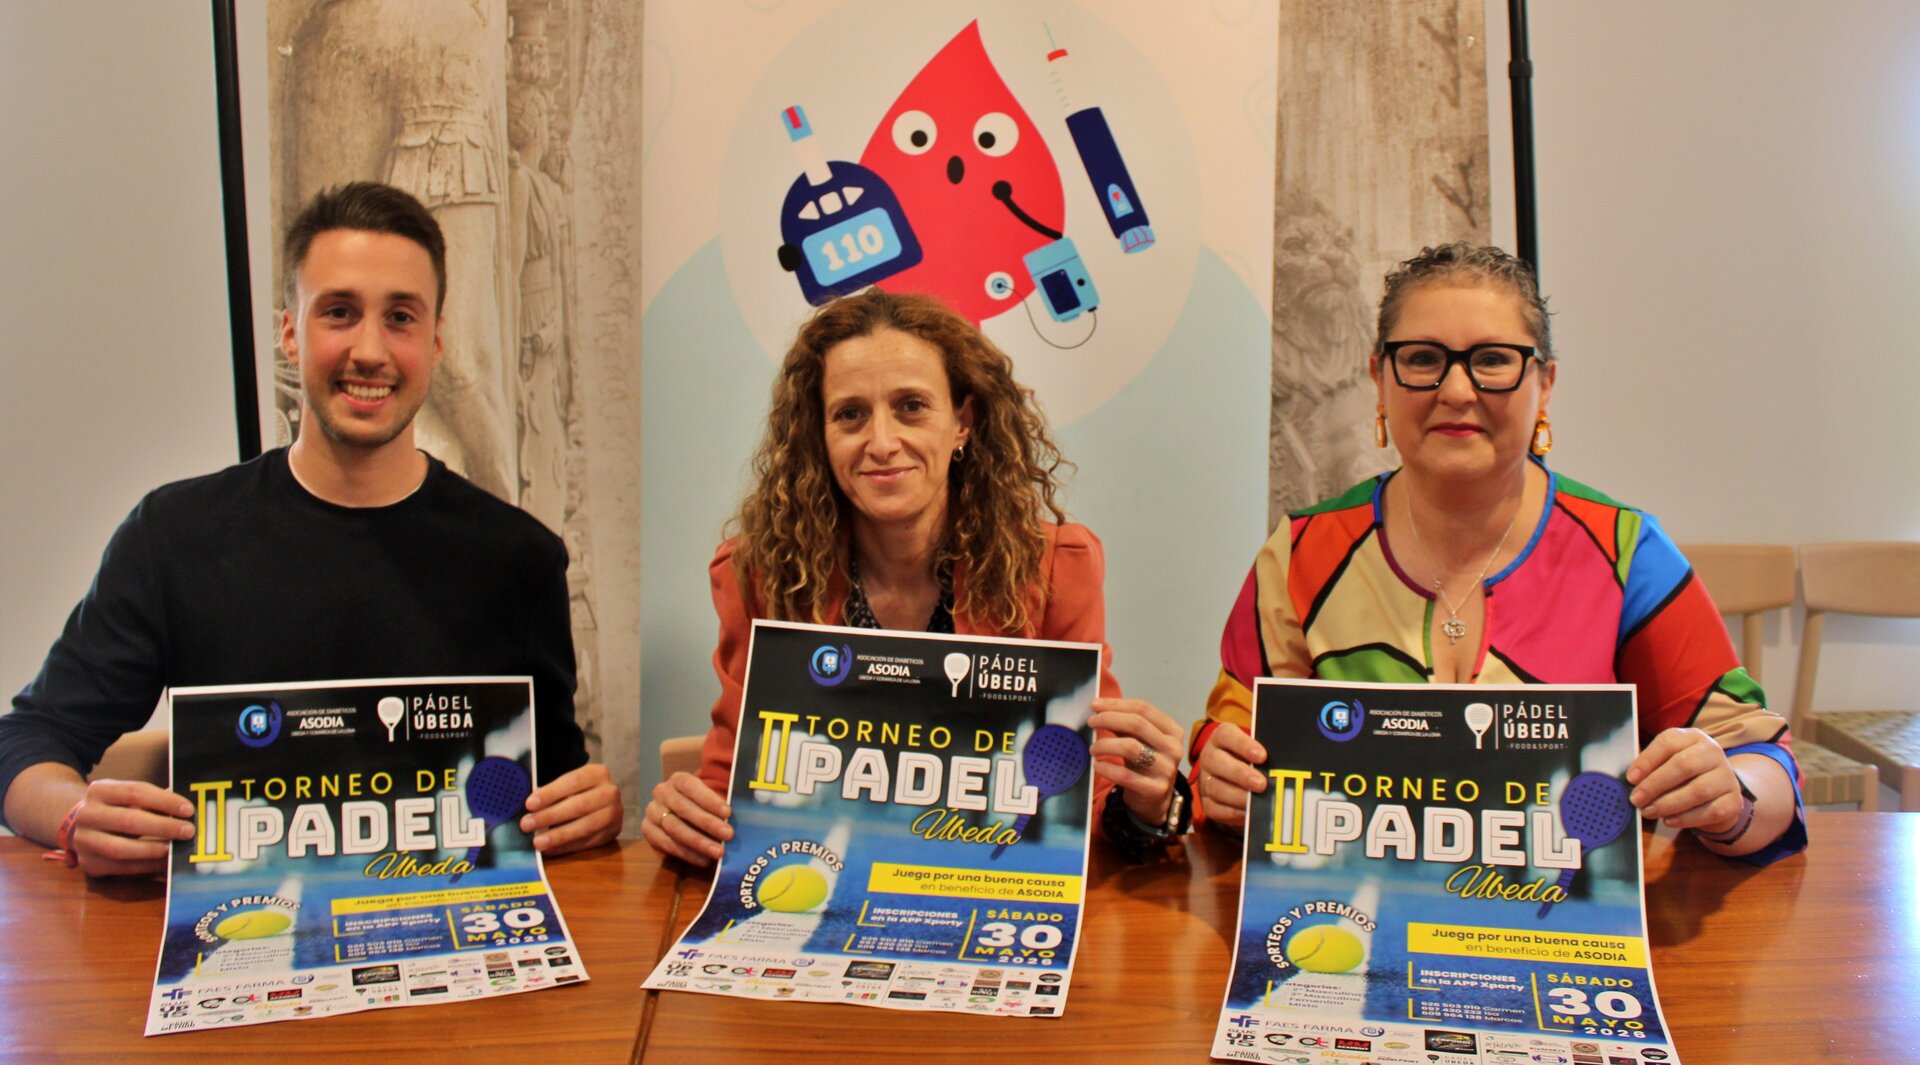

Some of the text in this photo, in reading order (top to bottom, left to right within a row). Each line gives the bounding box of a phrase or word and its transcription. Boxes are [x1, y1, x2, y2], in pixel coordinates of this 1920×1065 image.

[820, 224, 885, 272] 110
[867, 664, 910, 677] ASODIA
[980, 654, 1038, 674] PÁDEL
[978, 668, 1038, 692] ÚBEDA
[413, 694, 472, 711] PÁDEL
[1503, 701, 1568, 719] PÁDEL
[299, 716, 345, 729] ASODIA
[414, 710, 473, 730] ÚBEDA
[1382, 718, 1429, 730] ASODIA
[1504, 718, 1569, 739] ÚBEDA
[805, 714, 1016, 754] TORNEO DE
[240, 768, 457, 800] TORNEO DE
[796, 741, 1039, 816] PADEL
[1320, 772, 1550, 806] TORNEO DE
[238, 795, 486, 860] PADEL
[911, 807, 1021, 846] Úbeda
[1316, 801, 1582, 870] PADEL
[364, 850, 475, 881] Úbeda
[740, 841, 844, 910] SORTEOS Y PREMIOS
[893, 869, 1066, 887] Juega por una buena causa
[1445, 863, 1568, 904] Úbeda
[940, 883, 994, 895] beneficio
[998, 886, 1014, 896] de
[1016, 888, 1064, 898] ASODIA
[217, 903, 228, 913] Y
[231, 896, 301, 911] PREMIOS
[873, 908, 958, 919] INSCRIPCIONES
[462, 908, 545, 933] 30
[900, 916, 922, 924] APP
[924, 918, 963, 927] Xporty
[986, 908, 1063, 922] SÁBADO
[467, 927, 547, 942] MAYO
[978, 922, 1063, 950] 30
[1266, 901, 1377, 970] SORTEOS Y PREMIOS
[1432, 929, 1626, 950] Juega por una buena causa
[974, 946, 1056, 959] MAYO
[998, 956, 1053, 966] 2026
[1466, 944, 1627, 962] en beneficio de ASODIA
[1420, 970, 1516, 982] INSCRIPCIONES
[1546, 972, 1633, 989] SÁBADO
[1480, 982, 1525, 992] Xporty
[1483, 1006, 1526, 1014] Carmen
[1548, 988, 1643, 1020] 30
[1266, 1021, 1299, 1029] FAES
[1304, 1024, 1354, 1034] FARMA
[1552, 1015, 1645, 1030] MAYO
[1584, 1026, 1647, 1039] 2026
